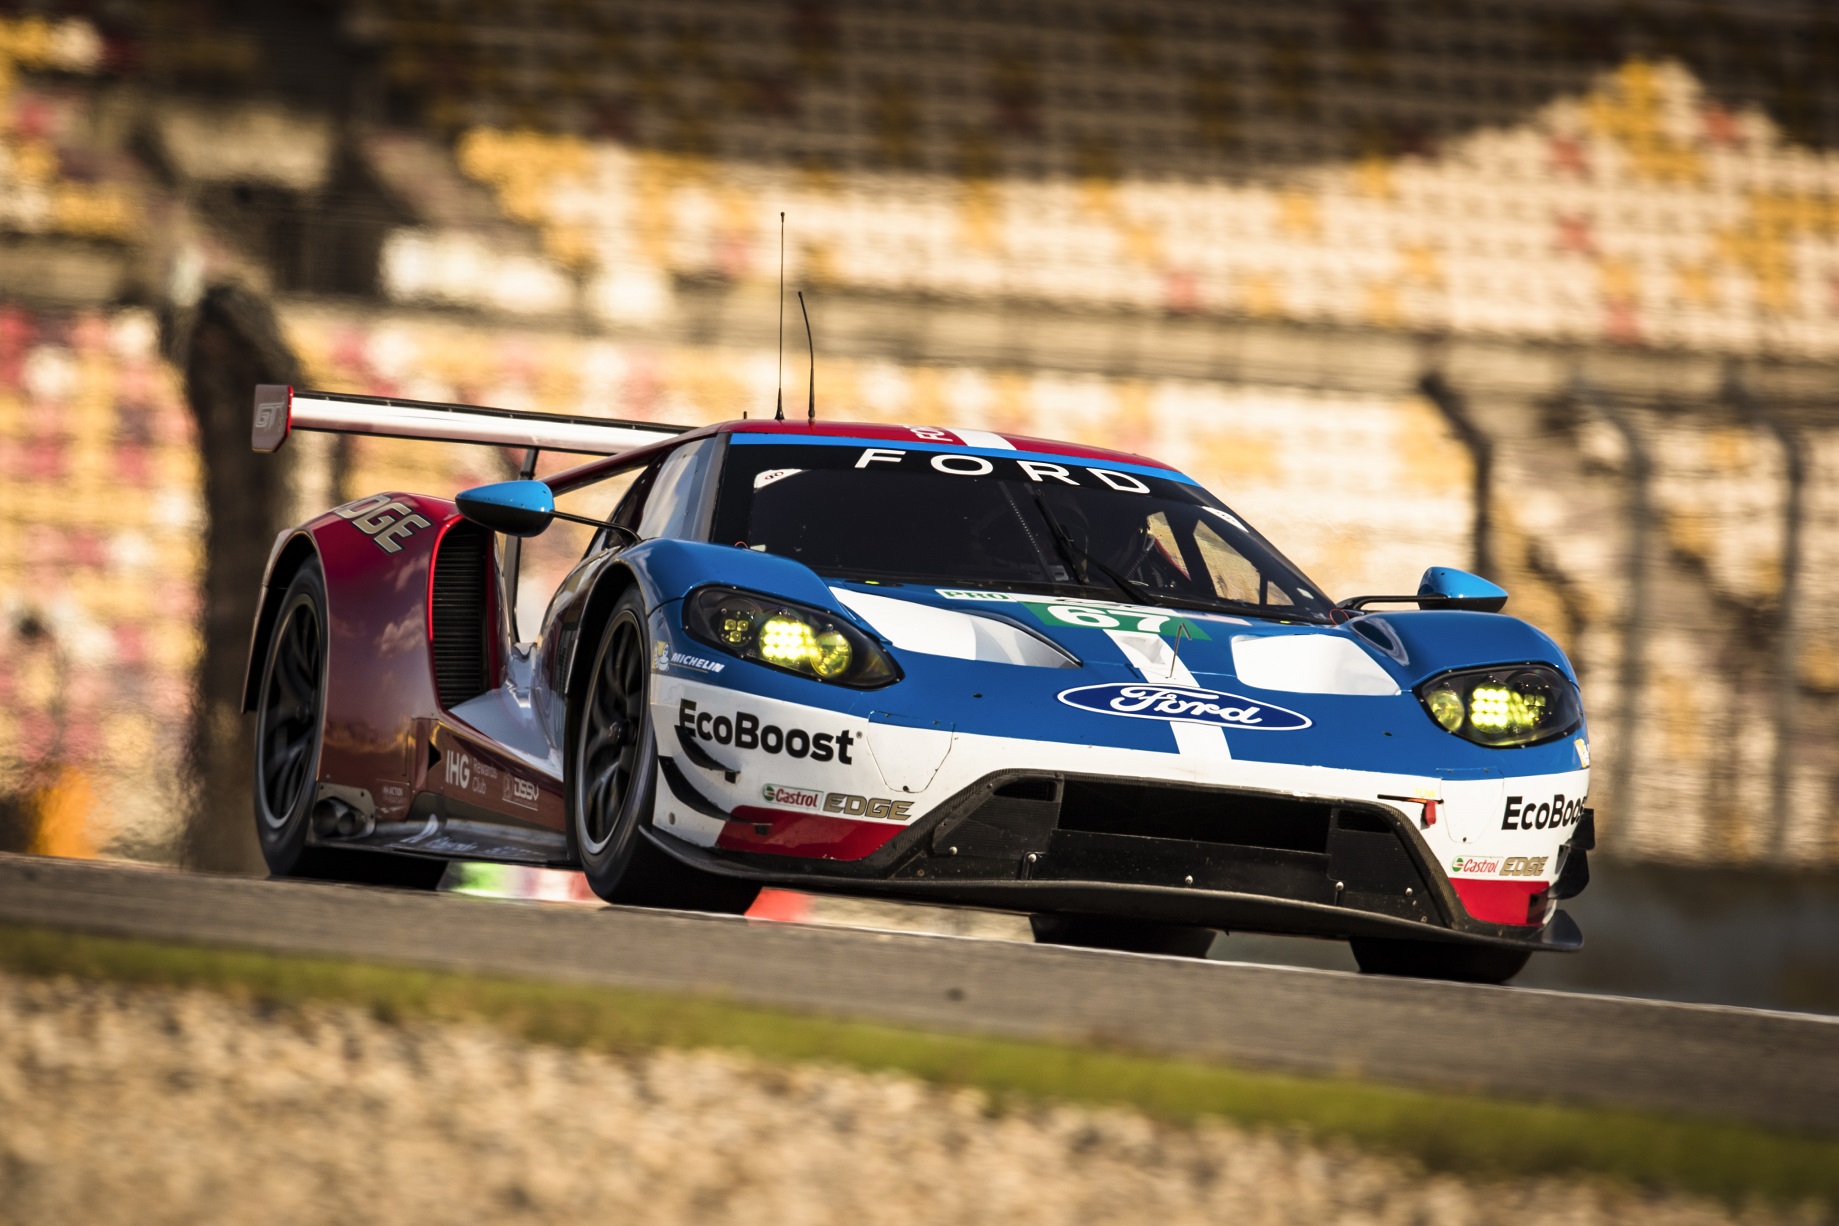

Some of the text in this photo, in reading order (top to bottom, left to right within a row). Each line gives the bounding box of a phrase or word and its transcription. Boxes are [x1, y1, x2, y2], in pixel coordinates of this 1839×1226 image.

[255, 402, 284, 428] GT
[855, 448, 1151, 494] FORD
[943, 591, 1010, 600] PRO
[1047, 606, 1171, 633] 67
[671, 653, 725, 673] MICHELIN
[1110, 686, 1263, 725] Ford
[679, 698, 855, 765] EcoBoost
[445, 750, 471, 789] IHG
[776, 788, 915, 821] Castrol EDGE
[1463, 857, 1549, 877] Castrol EDGE
